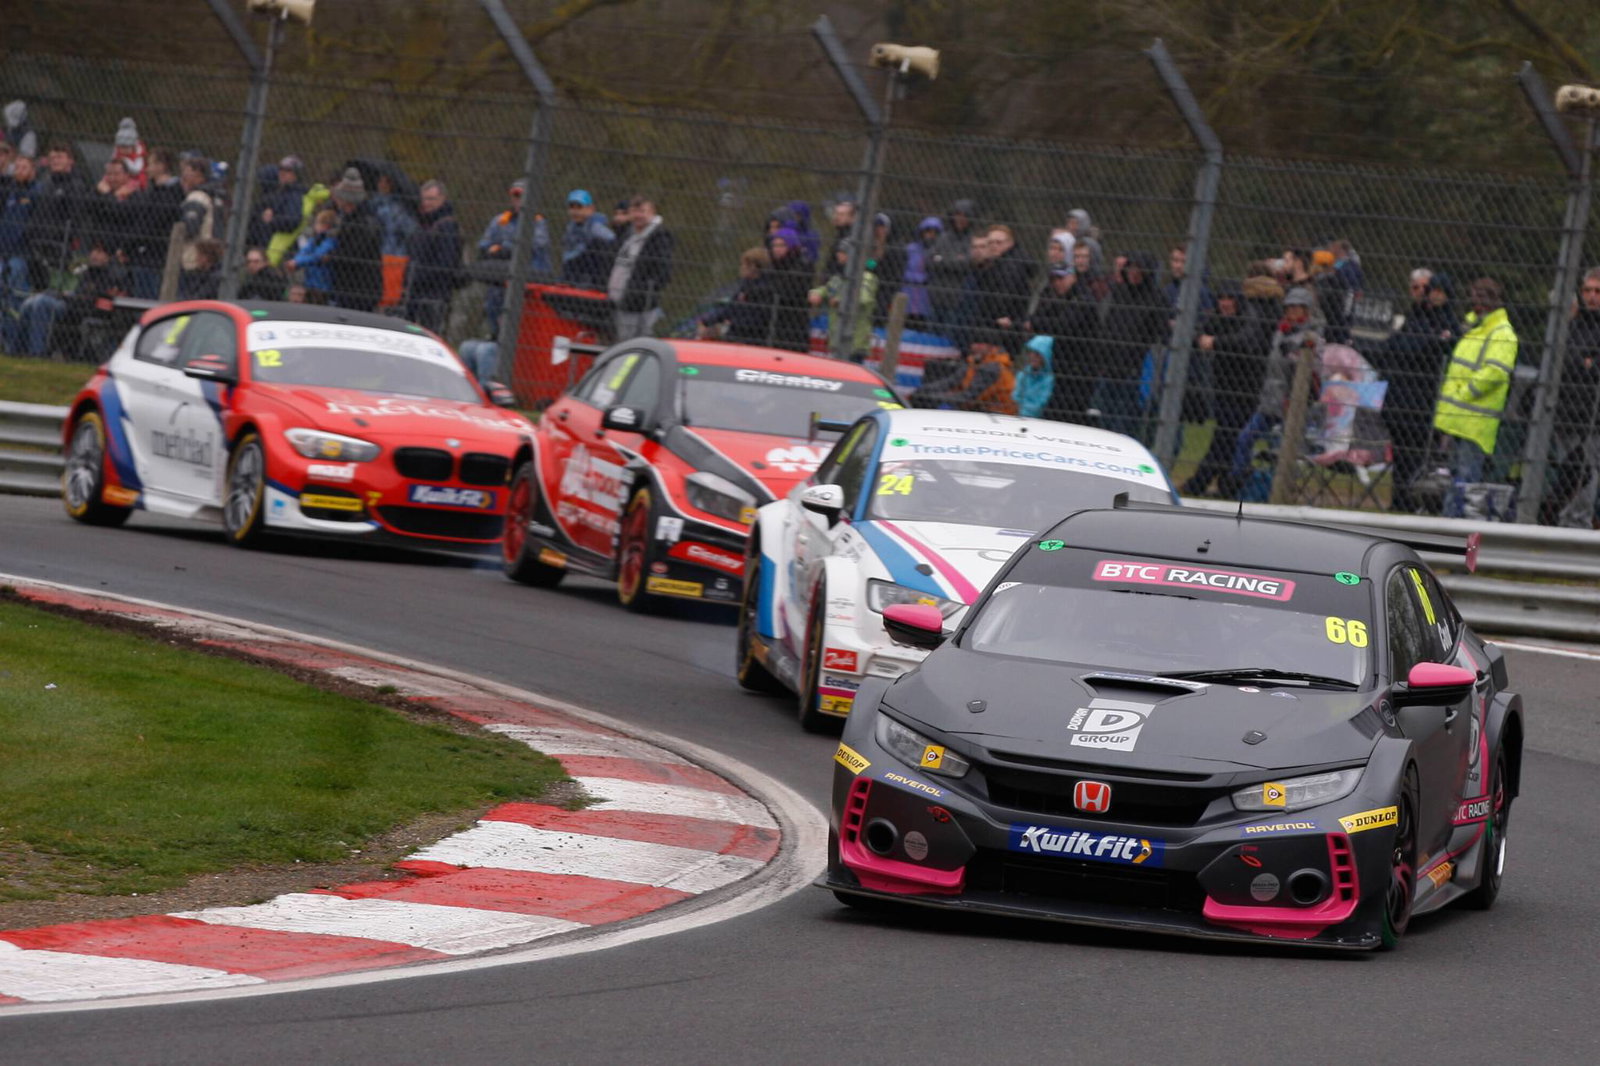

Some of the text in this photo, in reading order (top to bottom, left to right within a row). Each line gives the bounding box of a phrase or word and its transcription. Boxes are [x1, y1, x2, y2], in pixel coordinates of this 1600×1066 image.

[254, 349, 283, 367] 12
[922, 426, 1122, 453] FREDDIE WEEKS
[908, 443, 1145, 477] TradePriceCars.com
[876, 474, 915, 497] 24
[1100, 562, 1281, 596] BTC RACING
[1324, 616, 1368, 648] 66
[1078, 735, 1130, 744] GROUP
[836, 747, 866, 770] DUNLOP
[884, 772, 943, 798] RAVENOL
[1244, 821, 1315, 834] RAVENOL
[1355, 811, 1396, 827] DUNLOP
[1019, 825, 1139, 861] KwikFit
